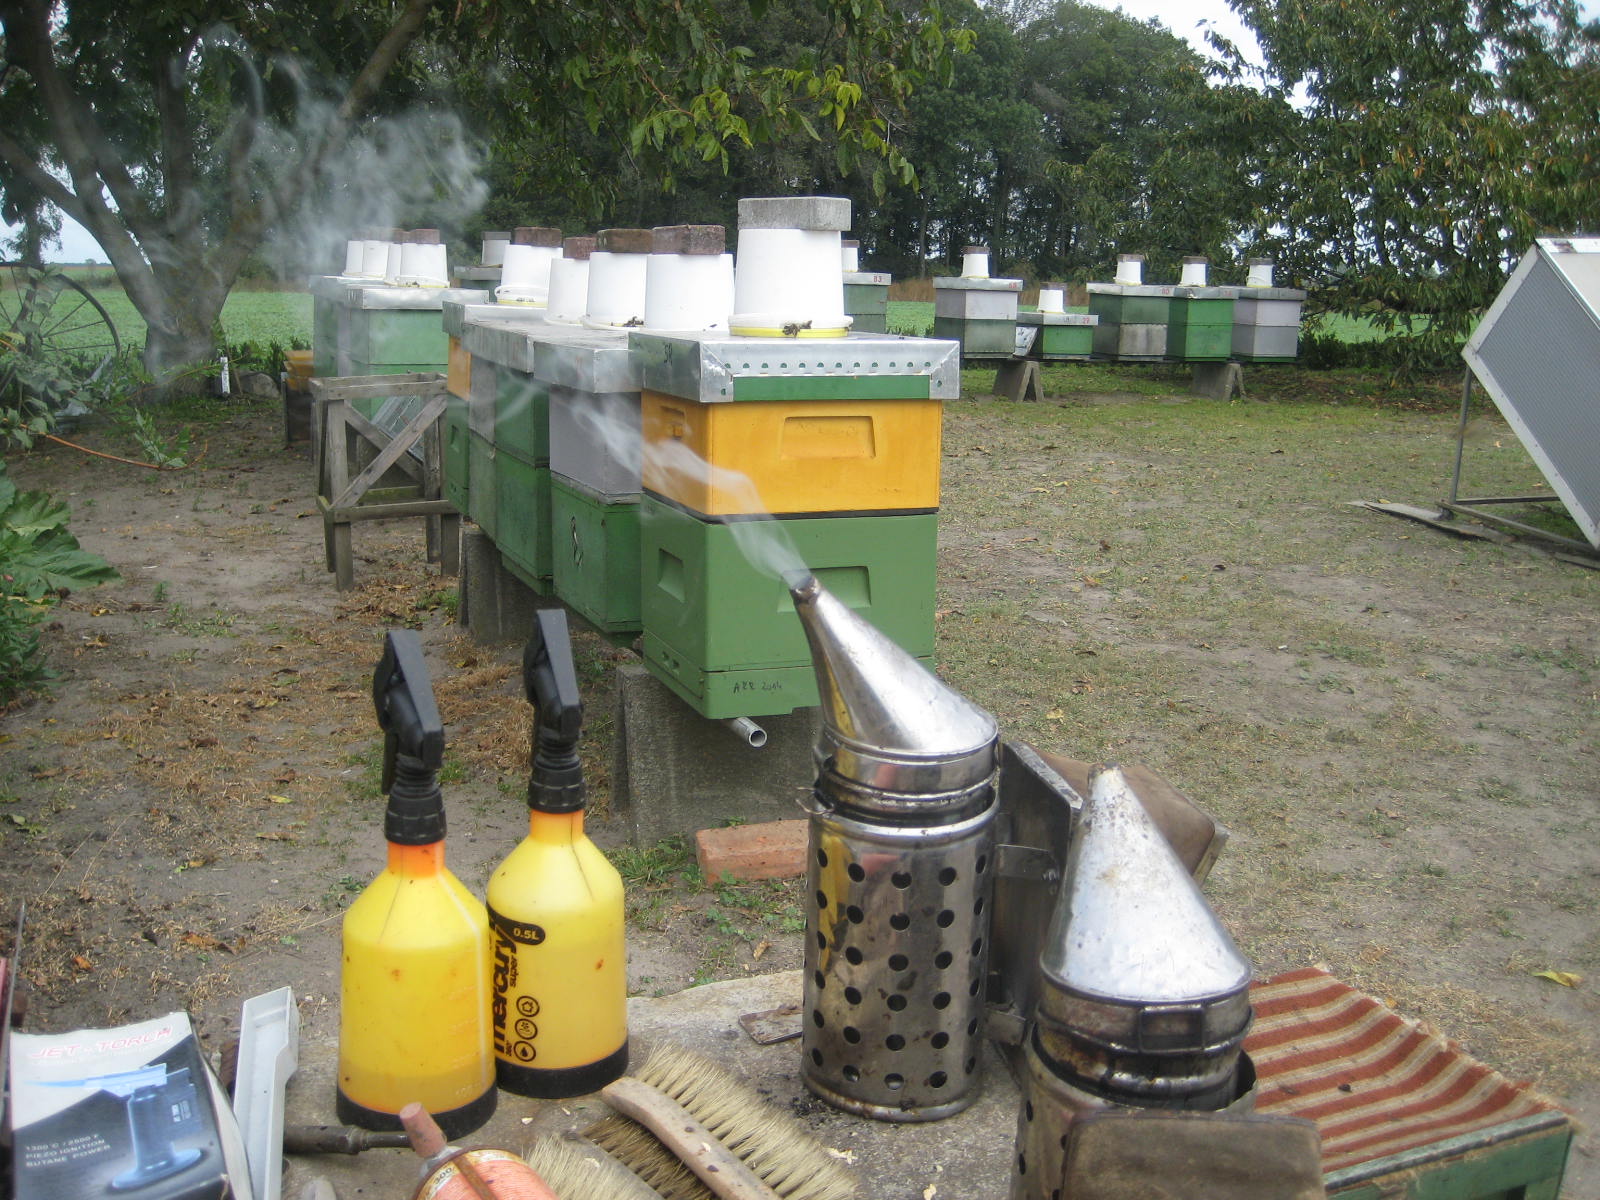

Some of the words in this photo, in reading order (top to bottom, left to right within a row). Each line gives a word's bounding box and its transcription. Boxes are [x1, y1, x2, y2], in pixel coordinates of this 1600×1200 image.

[513, 928, 540, 941] 0.5L
[510, 955, 519, 988] super
[492, 925, 517, 1054] mercury
